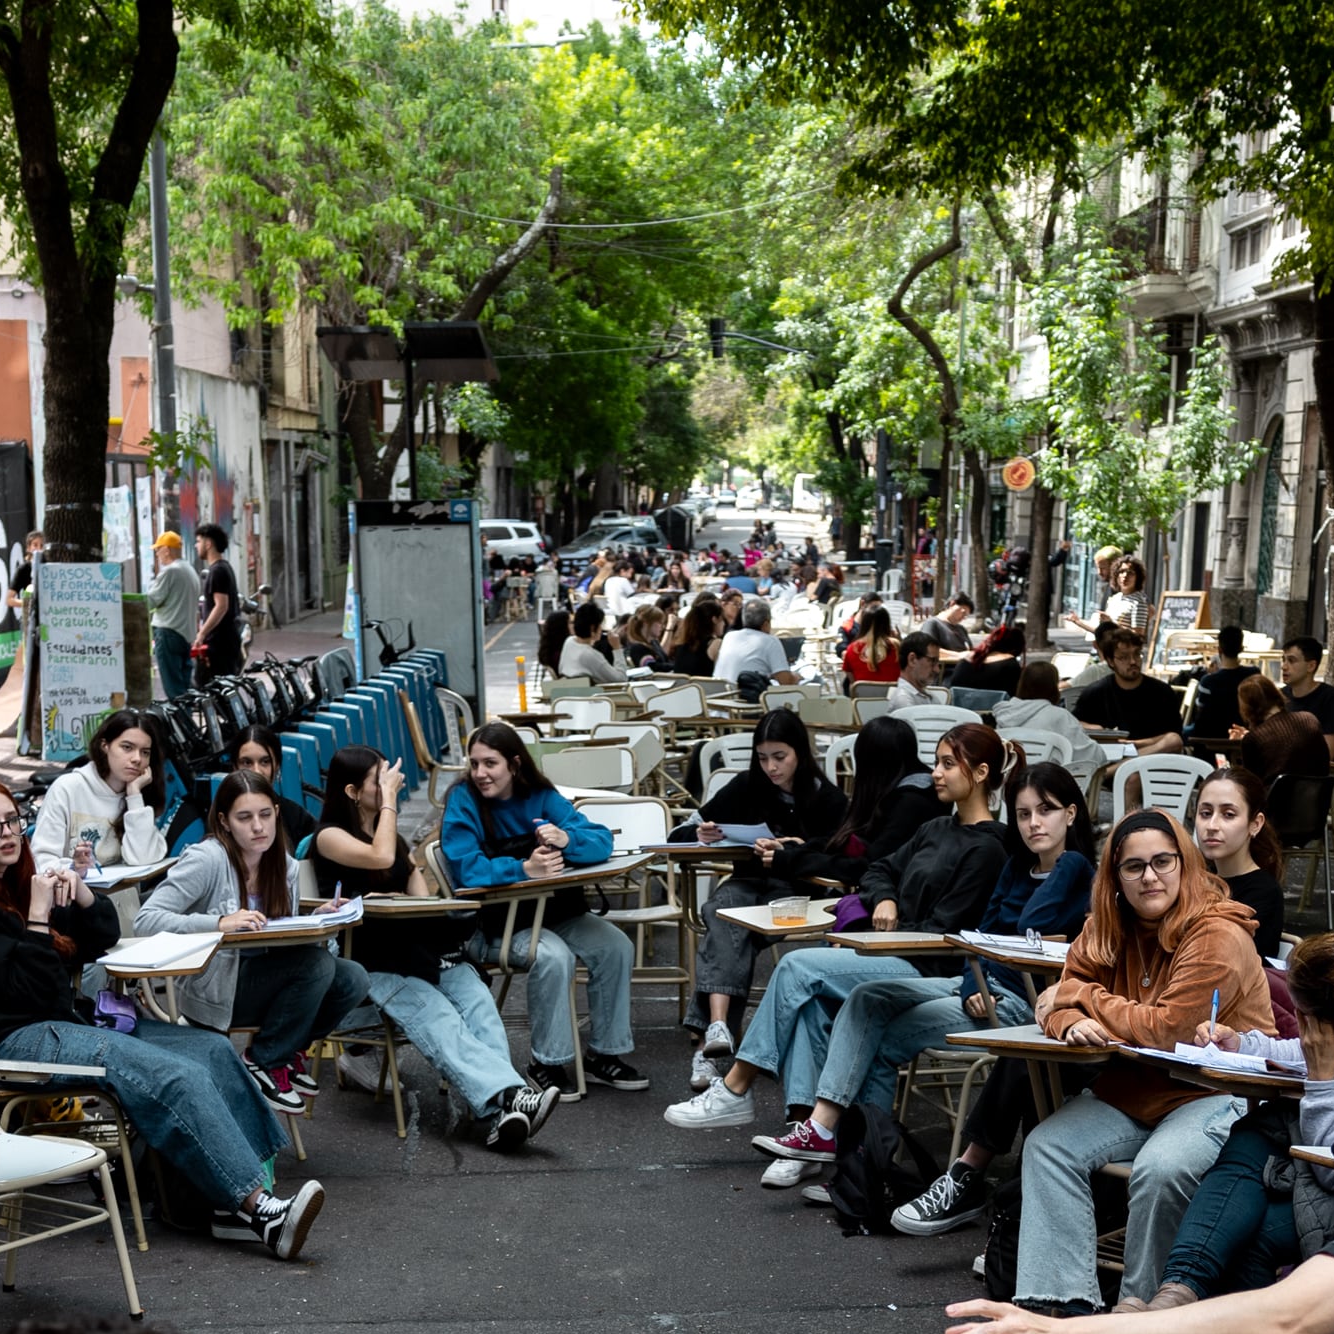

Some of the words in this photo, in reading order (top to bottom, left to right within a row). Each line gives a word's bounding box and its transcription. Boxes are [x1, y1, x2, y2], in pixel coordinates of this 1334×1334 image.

[41, 566, 93, 580] CURSOS
[43, 581, 56, 591] DE
[50, 591, 120, 603] PROFESIONAL
[51, 617, 109, 630] Gratuitos
[46, 643, 113, 656] Estudiantes
